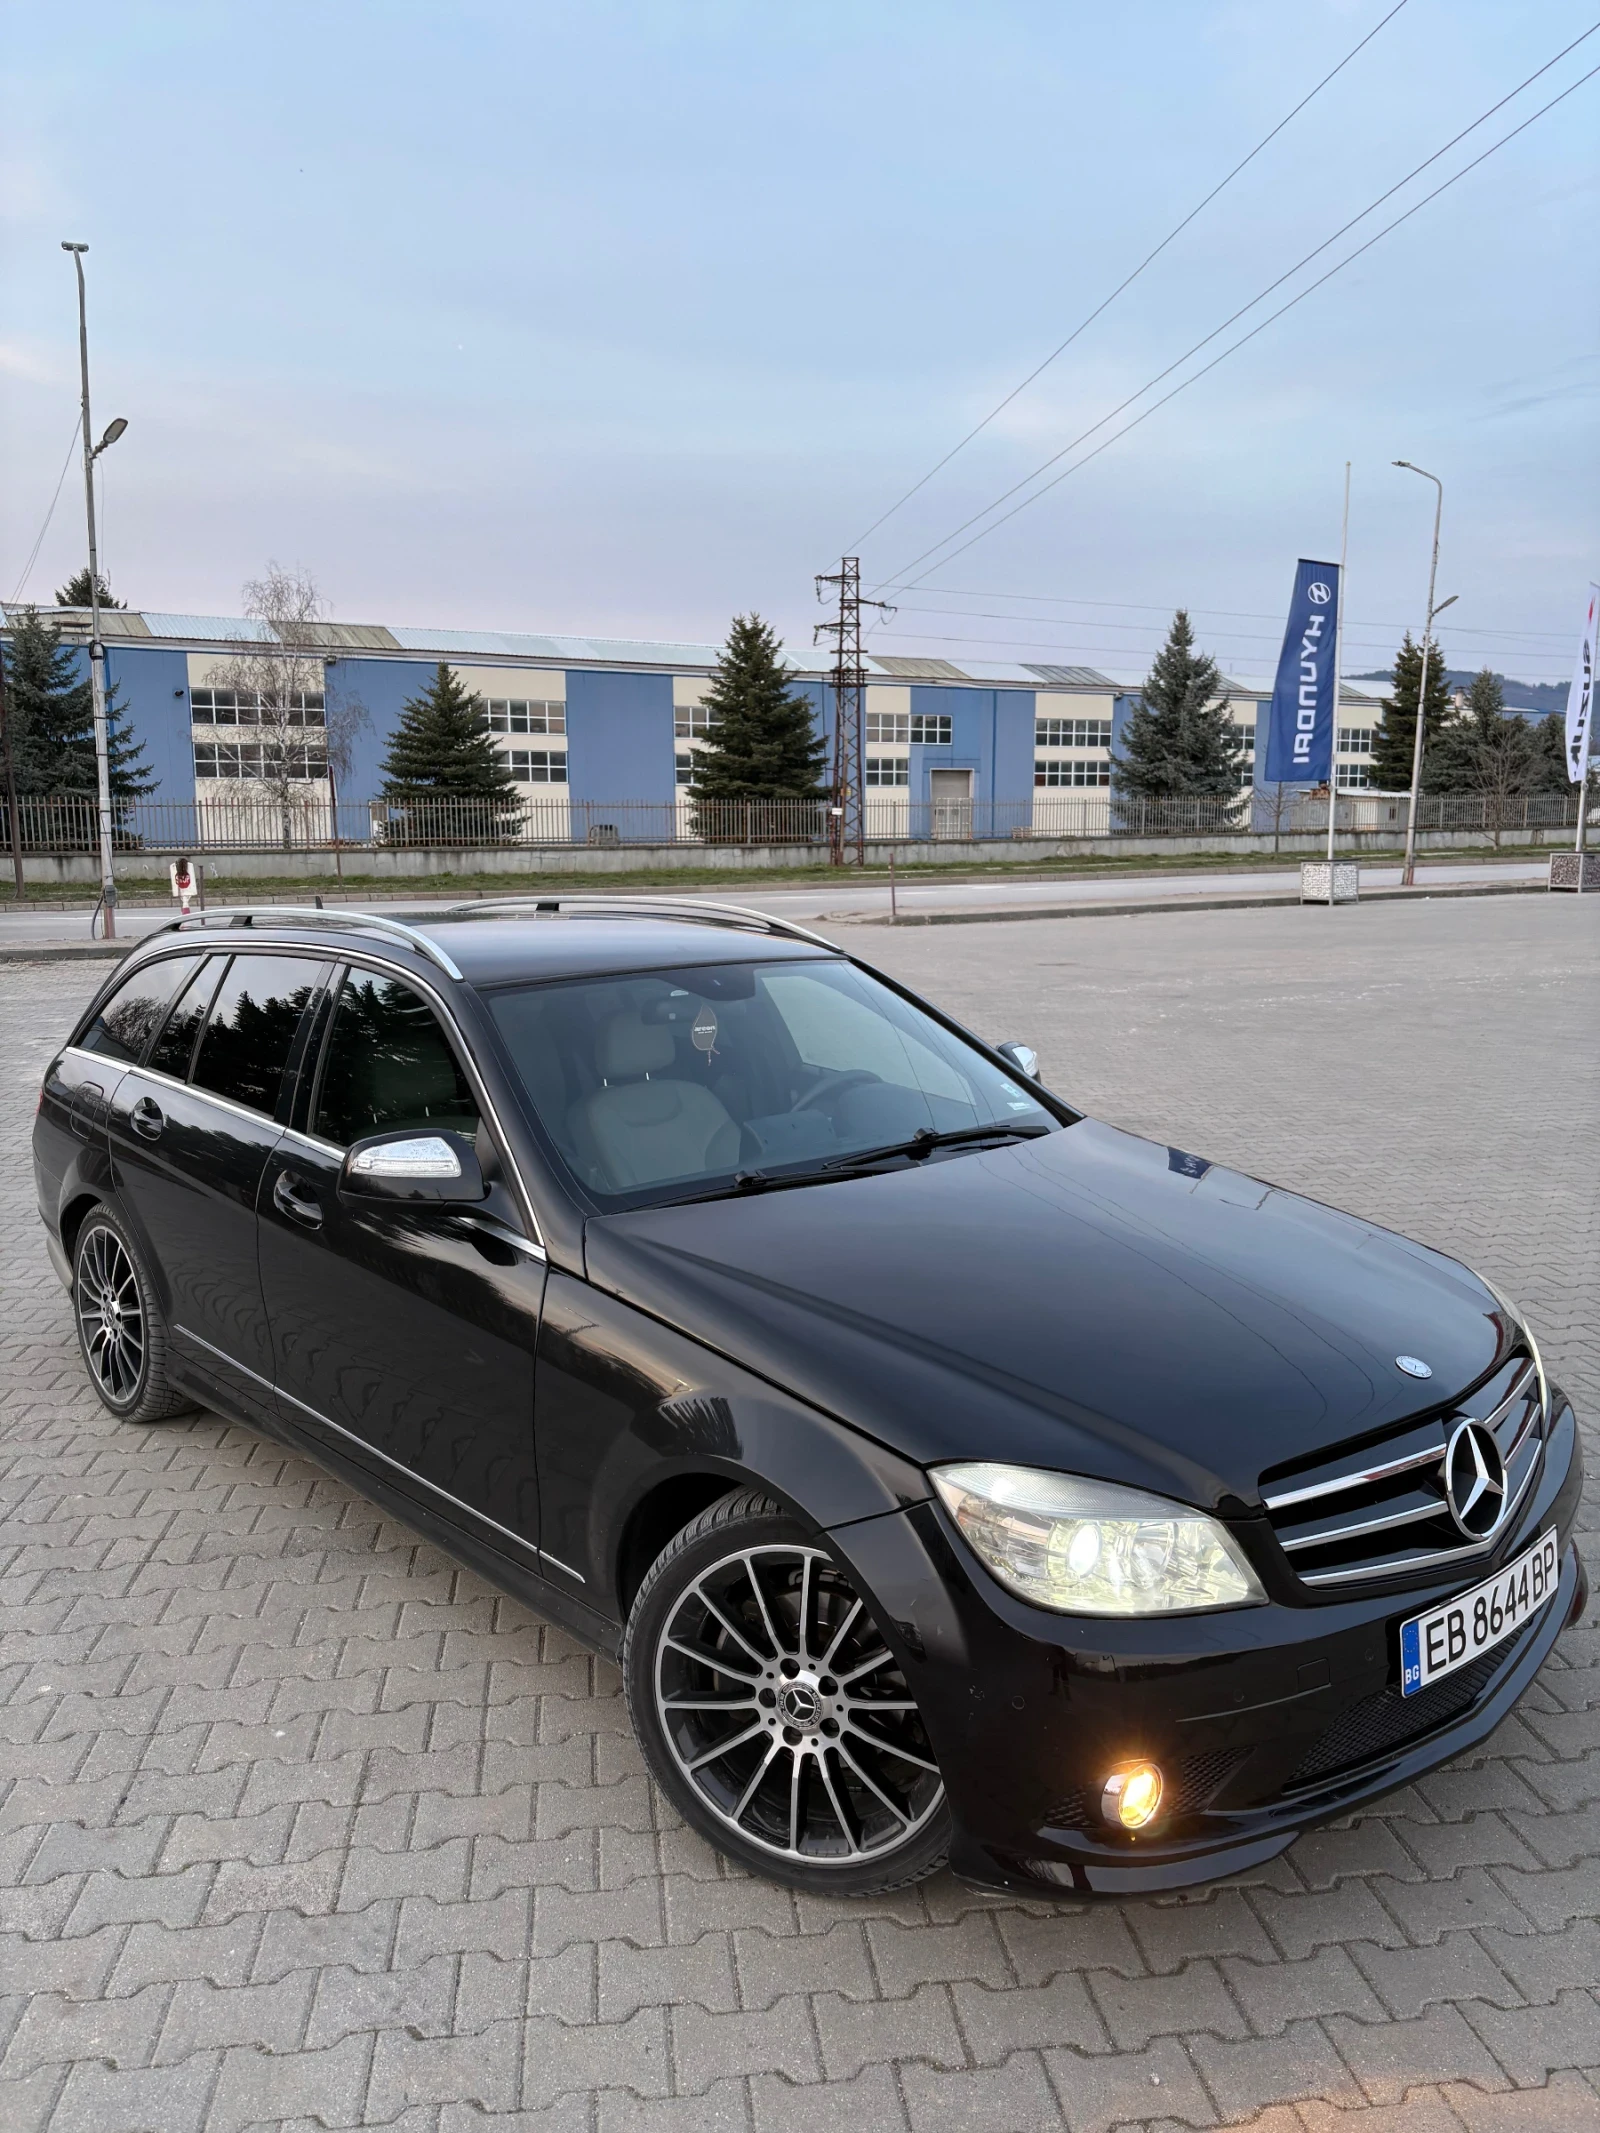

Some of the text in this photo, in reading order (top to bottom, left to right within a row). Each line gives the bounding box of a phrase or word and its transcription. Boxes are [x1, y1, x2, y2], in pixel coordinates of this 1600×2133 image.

[1425, 1541, 1555, 1675] EB 8644 BP
[1405, 1664, 1420, 1685] BG
